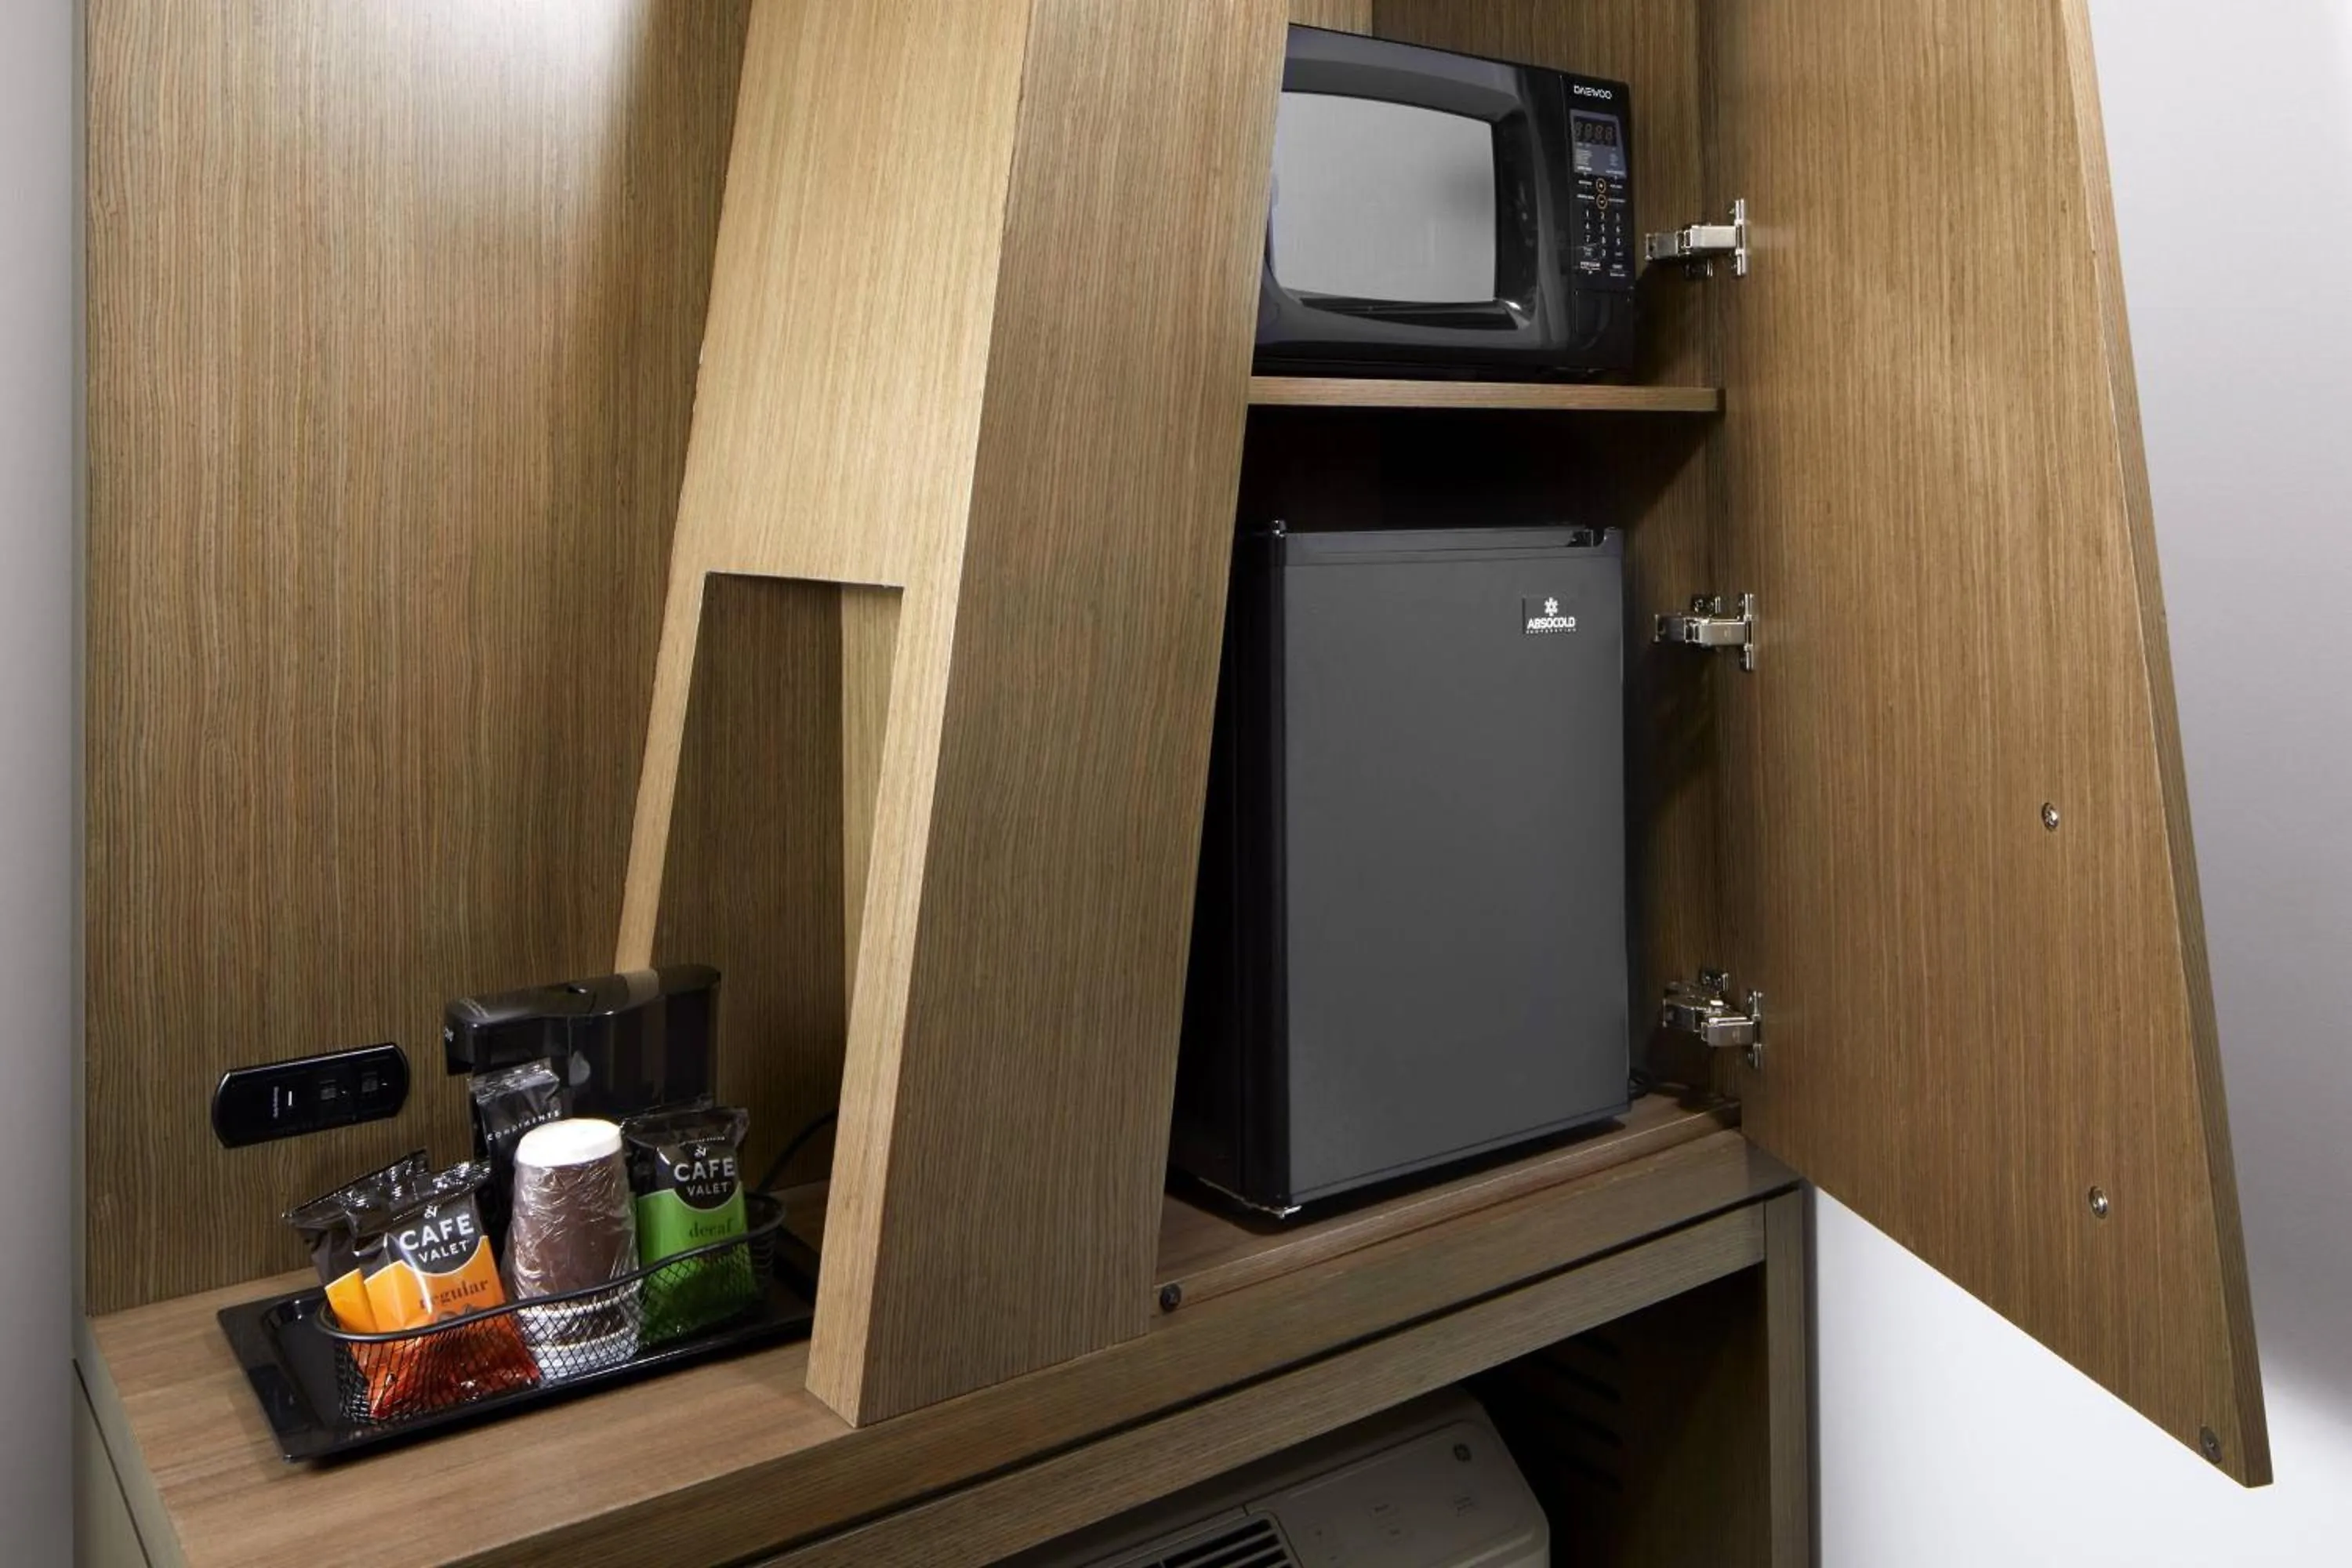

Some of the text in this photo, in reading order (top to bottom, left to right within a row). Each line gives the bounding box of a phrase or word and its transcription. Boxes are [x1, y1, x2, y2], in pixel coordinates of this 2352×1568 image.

[1573, 84, 1613, 100] DAEWOO
[1526, 616, 1576, 630] ABSOCOLD
[673, 1156, 735, 1182] CAFE
[686, 1181, 728, 1198] VALET
[399, 1213, 474, 1250] CAFE
[688, 1218, 734, 1239] decaf
[418, 1240, 469, 1263] VALET
